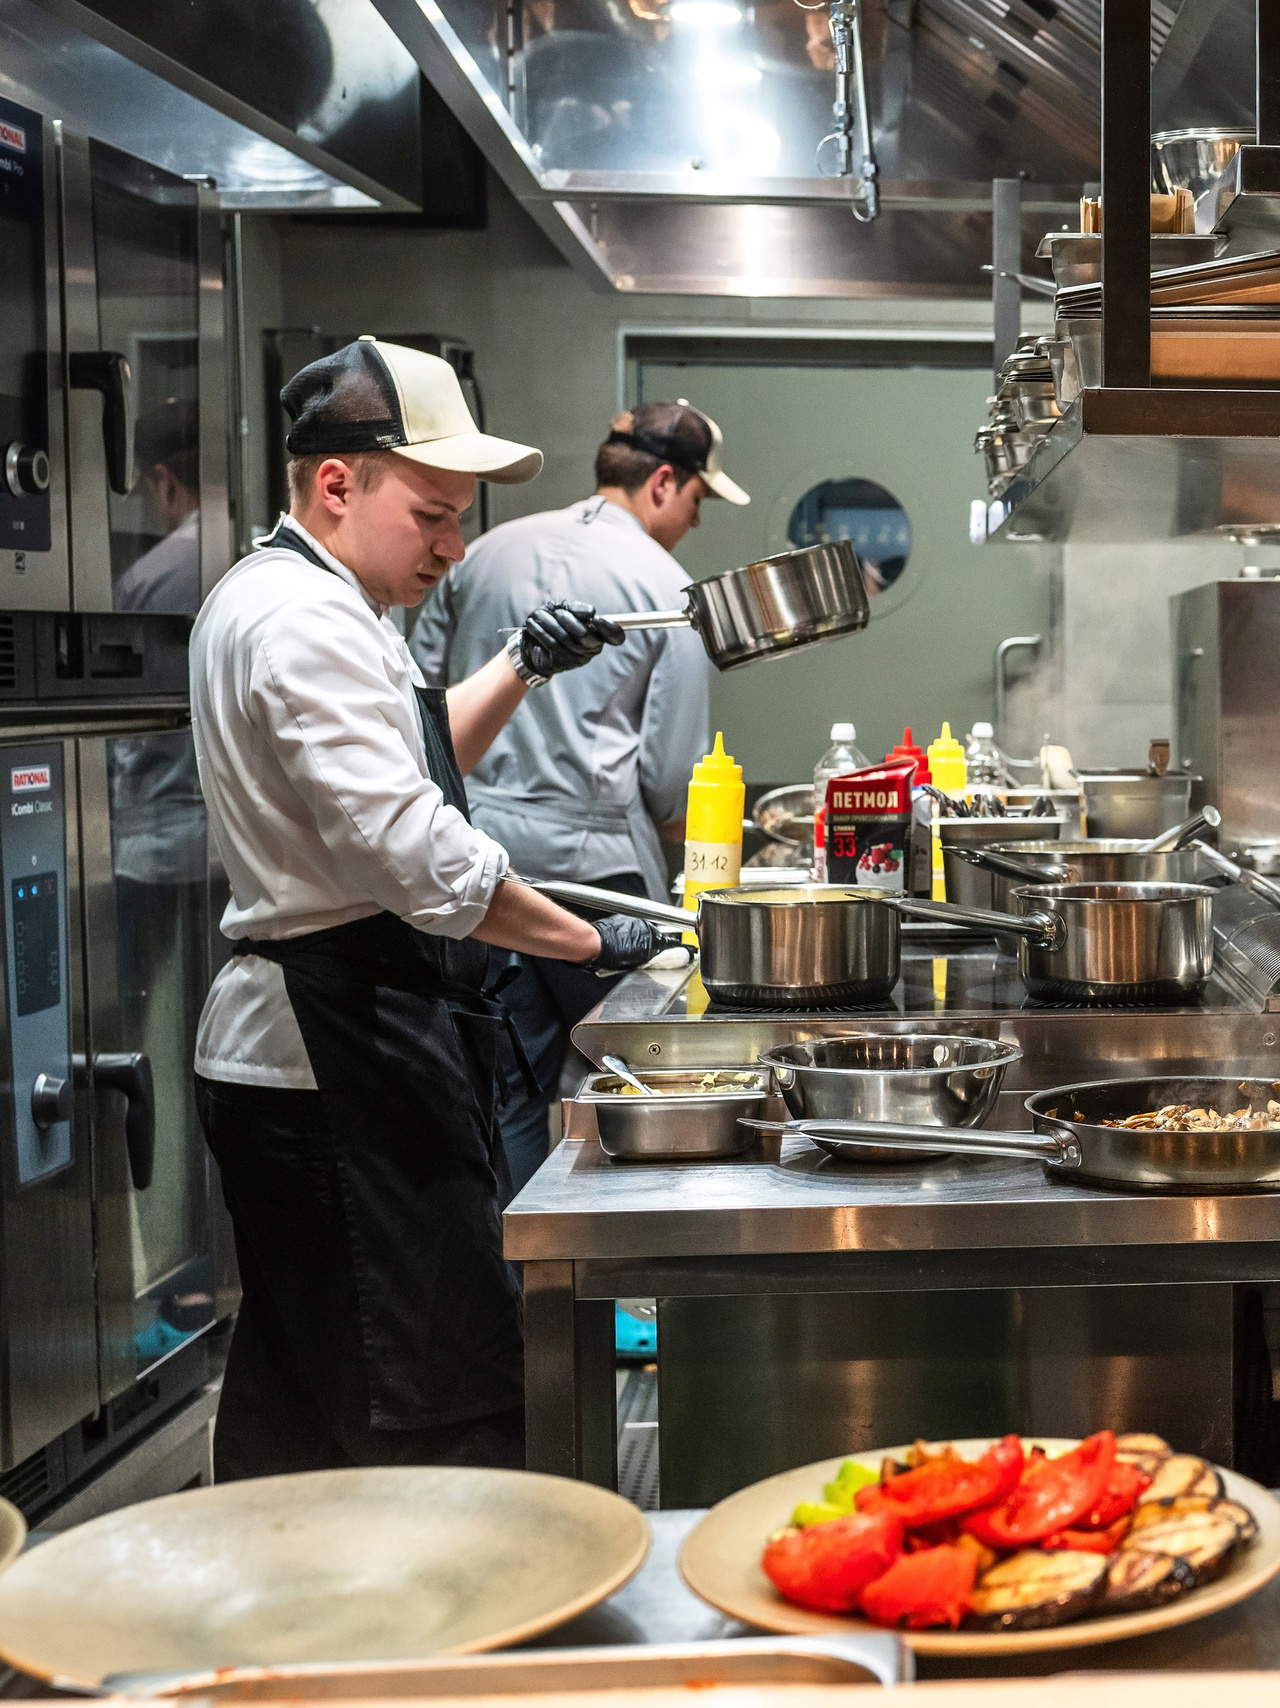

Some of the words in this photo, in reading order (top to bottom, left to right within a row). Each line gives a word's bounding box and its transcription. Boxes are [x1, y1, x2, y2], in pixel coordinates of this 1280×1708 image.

[14, 771, 48, 787] RATIONAL
[833, 791, 898, 809] ПЕТМОЛ
[833, 837, 856, 858] 33
